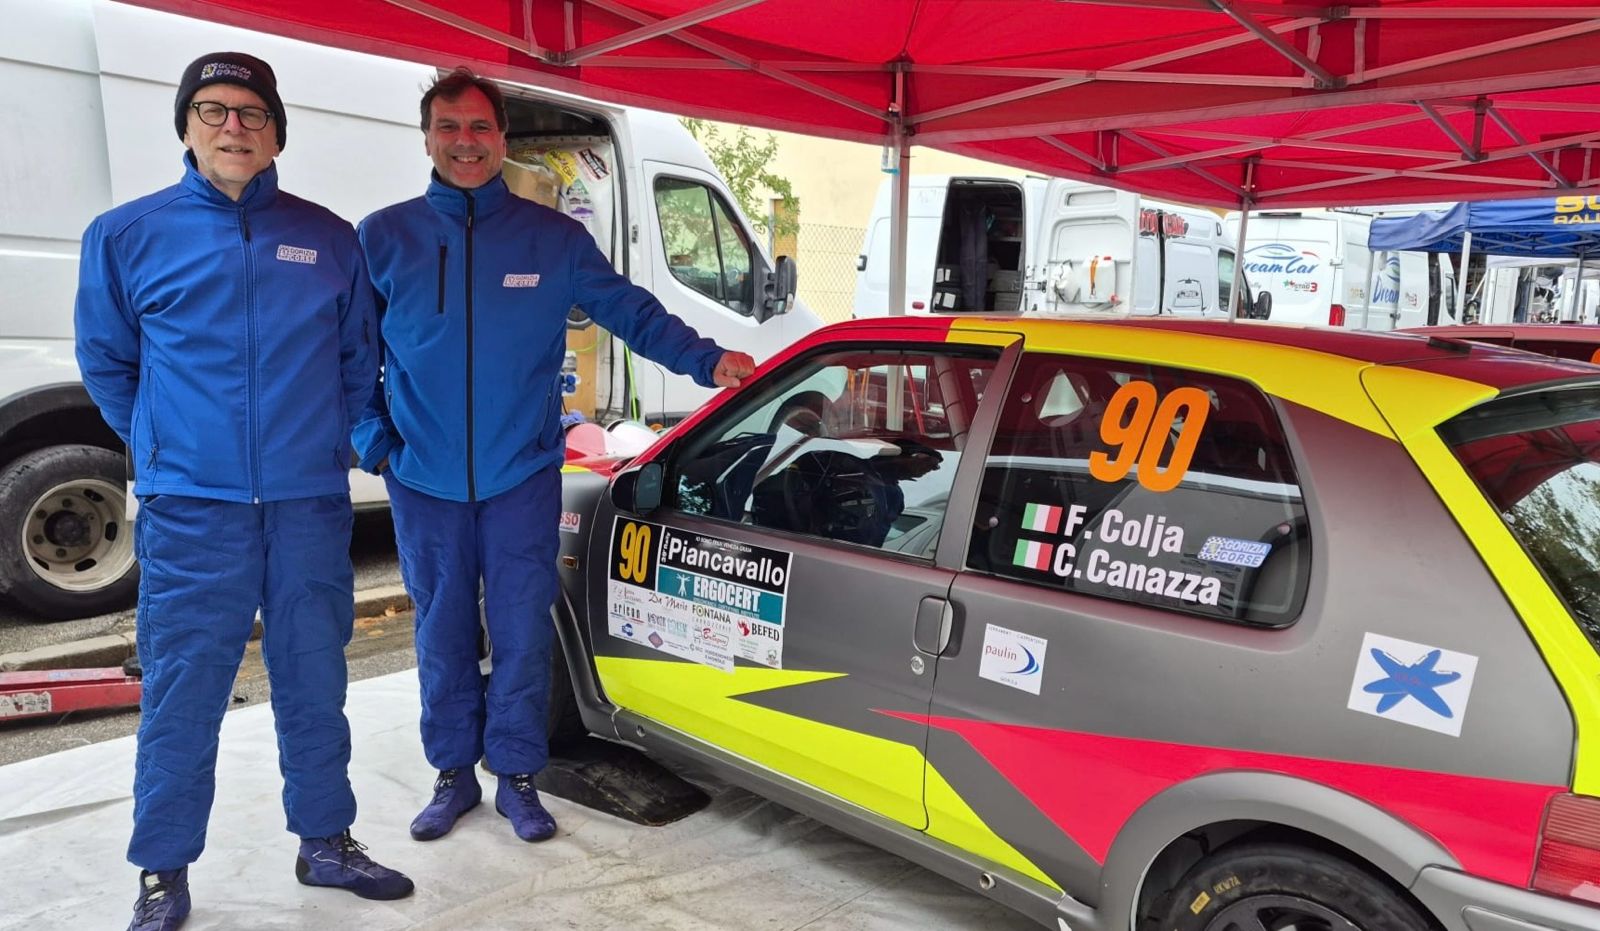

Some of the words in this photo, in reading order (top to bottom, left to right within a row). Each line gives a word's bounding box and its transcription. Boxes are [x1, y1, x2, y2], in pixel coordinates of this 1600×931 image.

[1285, 256, 1319, 274] Car
[1089, 380, 1210, 492] 90
[1064, 504, 1092, 540] F.
[1100, 509, 1185, 557] Colja
[619, 521, 652, 584] 90
[1219, 551, 1262, 566] CORSE
[1225, 540, 1267, 555] GORIZIA
[668, 537, 785, 587] Piancavallo
[1053, 543, 1081, 578] C.
[1086, 553, 1222, 606] Canazza
[693, 578, 761, 612] ERGOCERT
[692, 604, 732, 624] FONTANA
[751, 622, 780, 642] BEFED
[985, 645, 1017, 661] paulin
